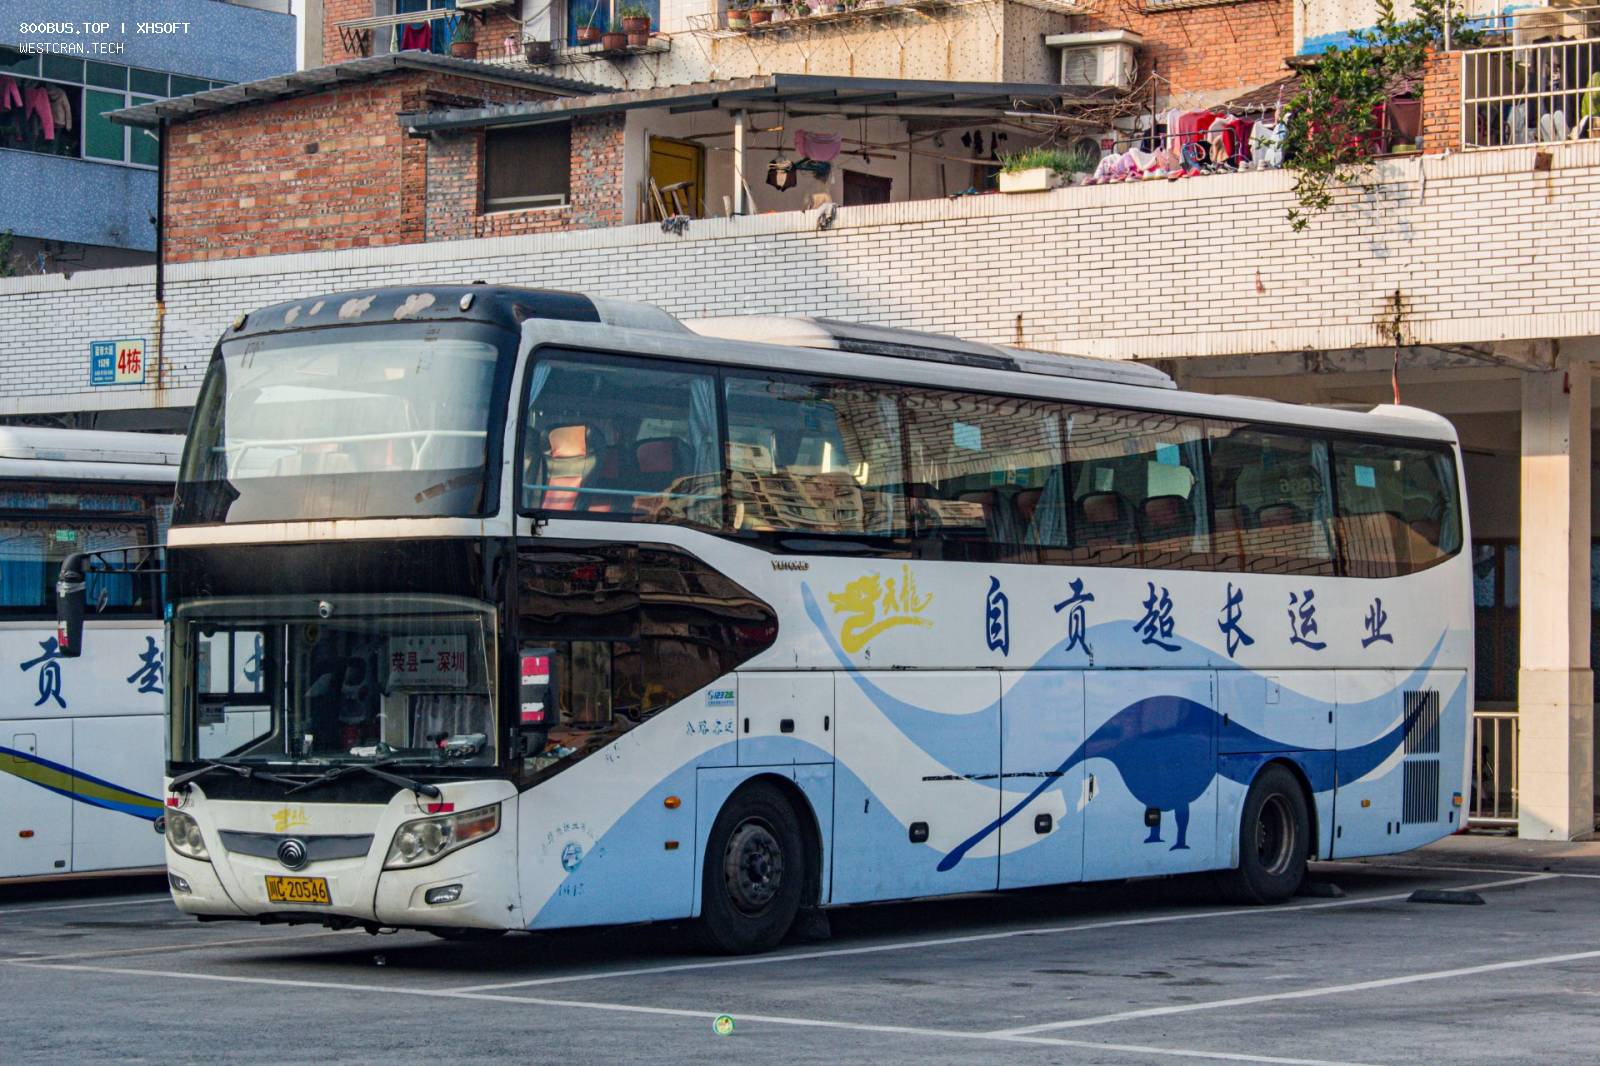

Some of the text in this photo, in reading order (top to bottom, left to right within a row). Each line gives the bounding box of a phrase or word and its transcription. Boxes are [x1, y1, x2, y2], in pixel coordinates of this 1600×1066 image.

[117, 348, 142, 374] 4栋
[984, 575, 1395, 658] 自贡超长运业
